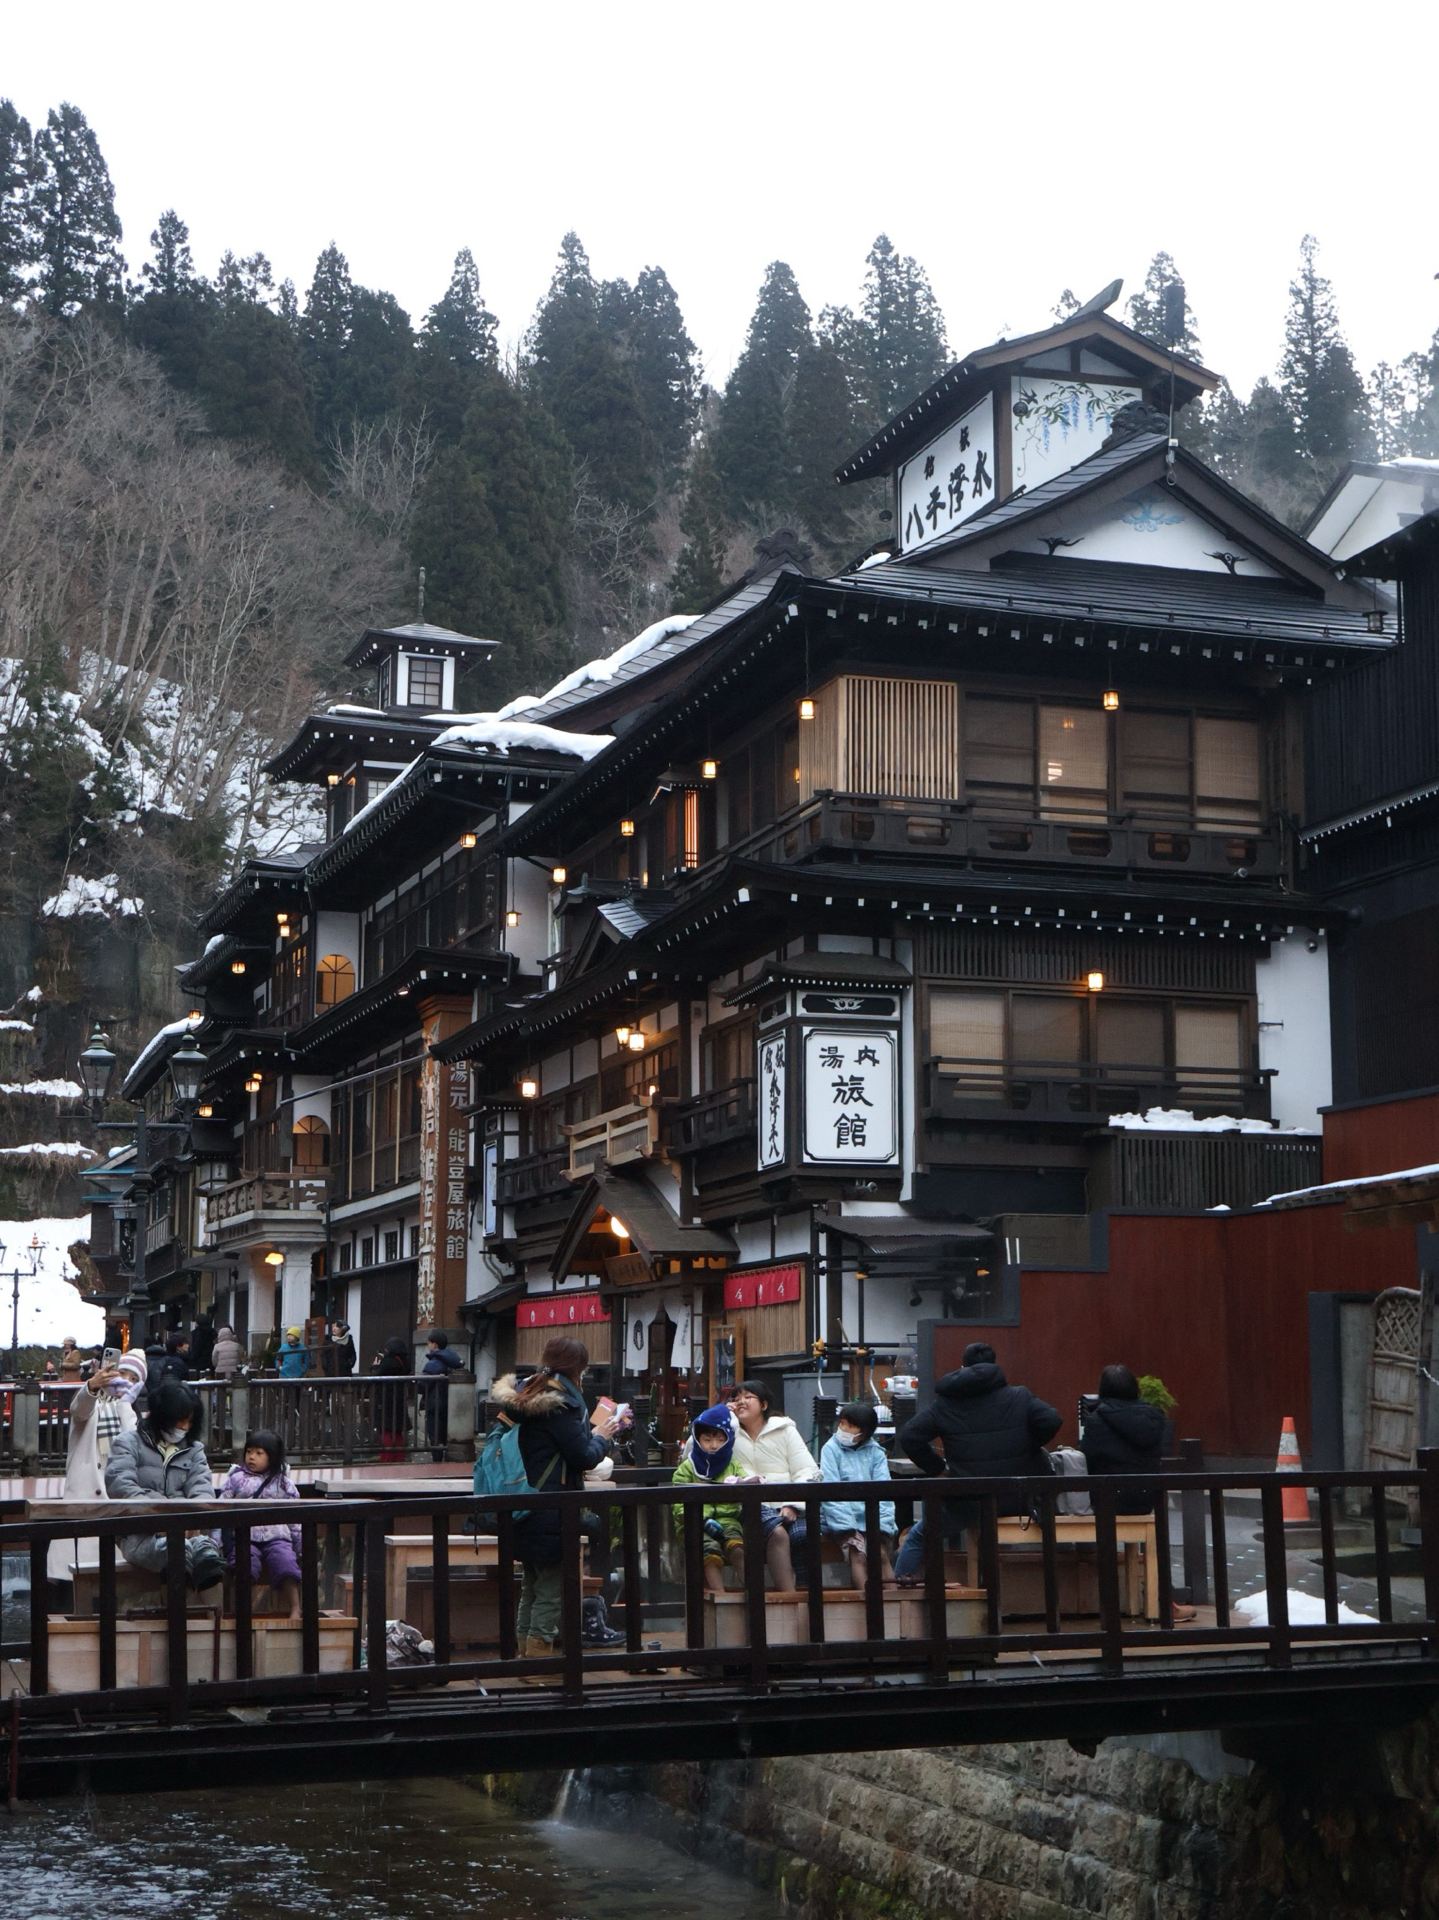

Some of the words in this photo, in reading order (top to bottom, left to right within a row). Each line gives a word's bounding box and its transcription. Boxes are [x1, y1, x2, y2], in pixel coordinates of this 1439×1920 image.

[450, 1060, 468, 1110] 湯元
[818, 1045, 880, 1070] 内湯
[831, 1074, 874, 1149] 旅館
[446, 1127, 466, 1260] 能登屋旅館
